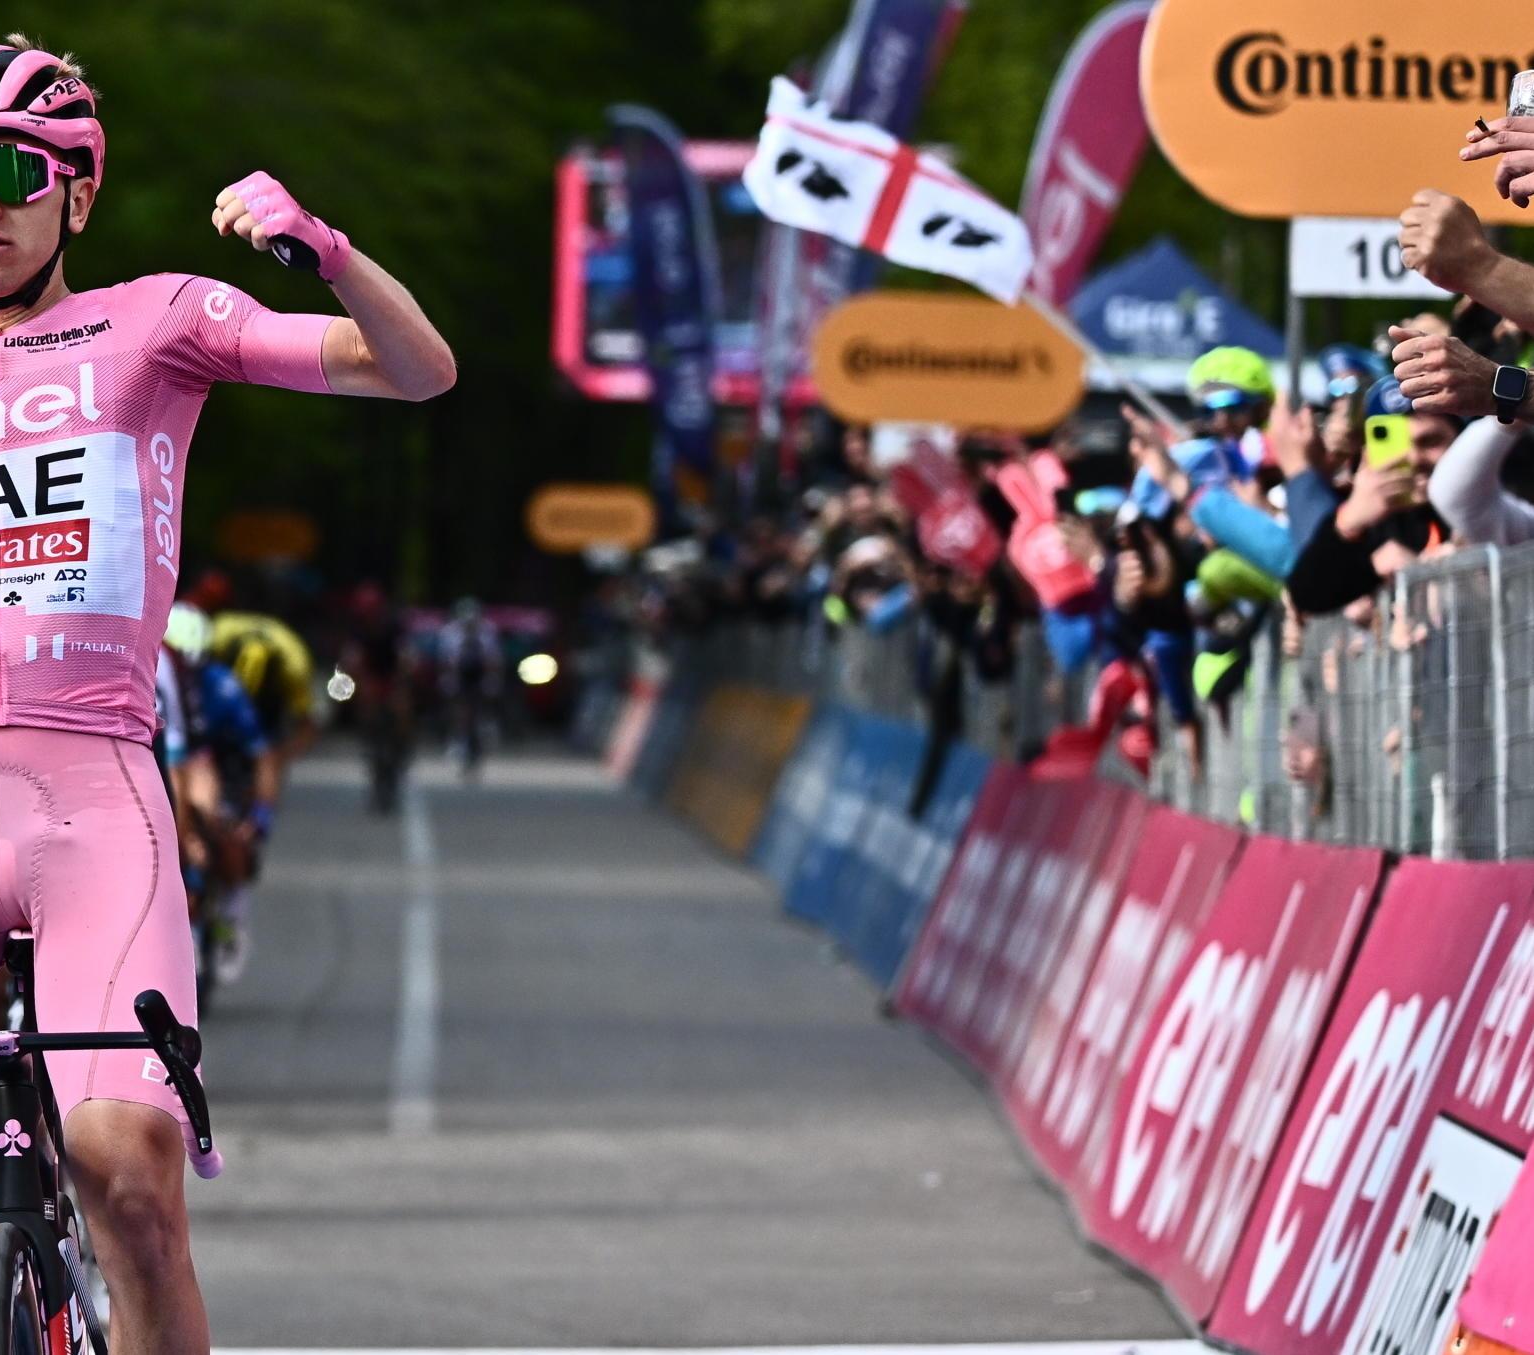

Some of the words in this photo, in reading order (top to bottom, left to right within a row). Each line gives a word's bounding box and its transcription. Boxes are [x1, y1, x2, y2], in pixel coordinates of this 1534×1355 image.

[1215, 29, 1534, 117] Continen
[1347, 236, 1410, 283] 10
[4, 337, 16, 348] La
[16, 332, 60, 347] Gazzetta
[60, 327, 84, 342] dello
[83, 318, 112, 336] Sport
[150, 432, 179, 581] enel
[54, 568, 88, 581] ADQ
[70, 641, 127, 655] ITALIA.IT
[1244, 901, 1510, 1337] enel
